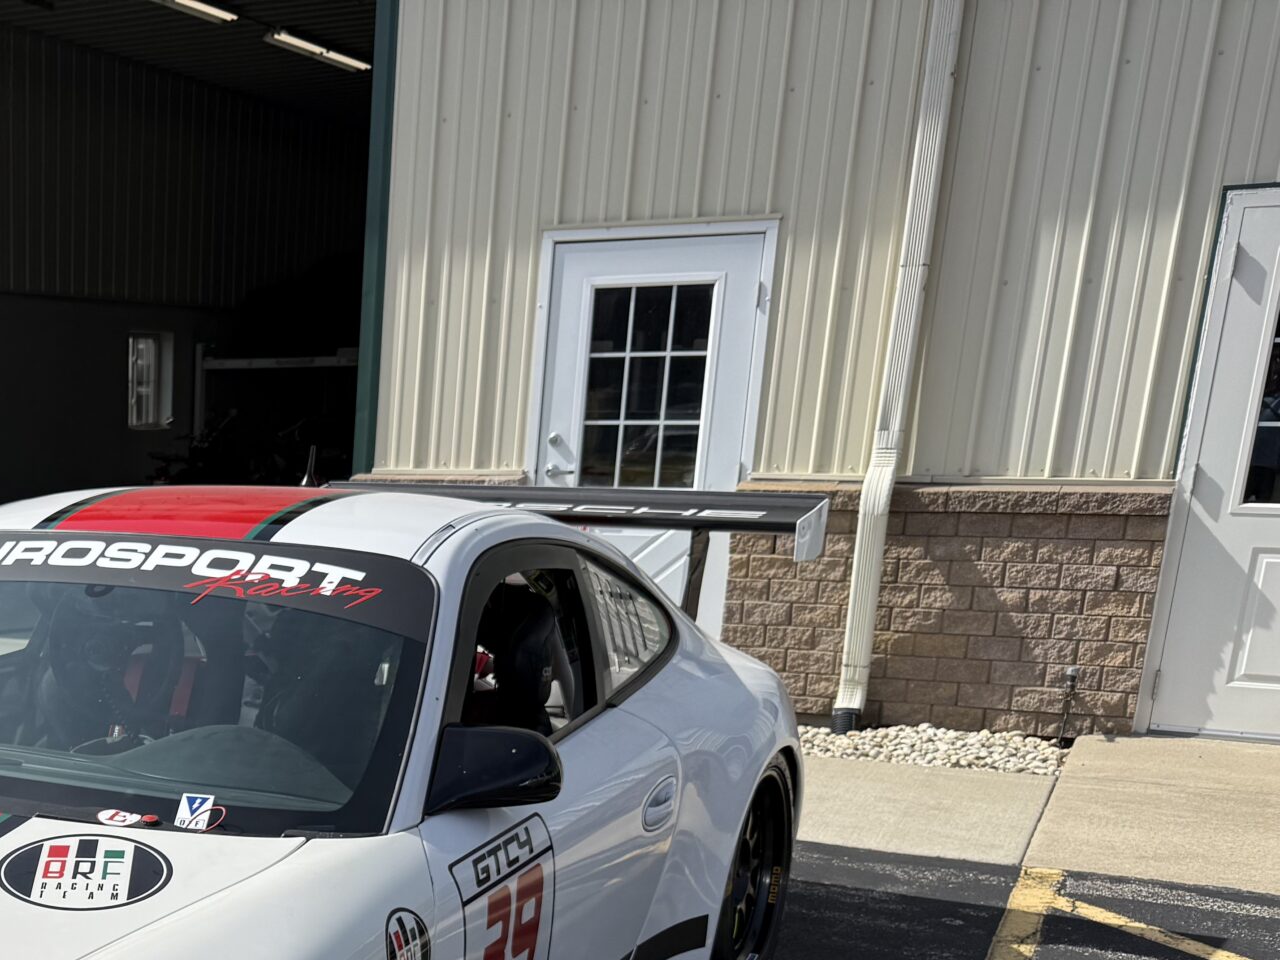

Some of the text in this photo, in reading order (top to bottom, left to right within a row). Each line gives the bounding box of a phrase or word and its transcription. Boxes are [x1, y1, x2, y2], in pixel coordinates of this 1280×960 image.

[183, 568, 384, 609] Racing
[472, 826, 534, 888] GTC4
[39, 890, 119, 901] TEAM
[40, 882, 120, 892] RACING
